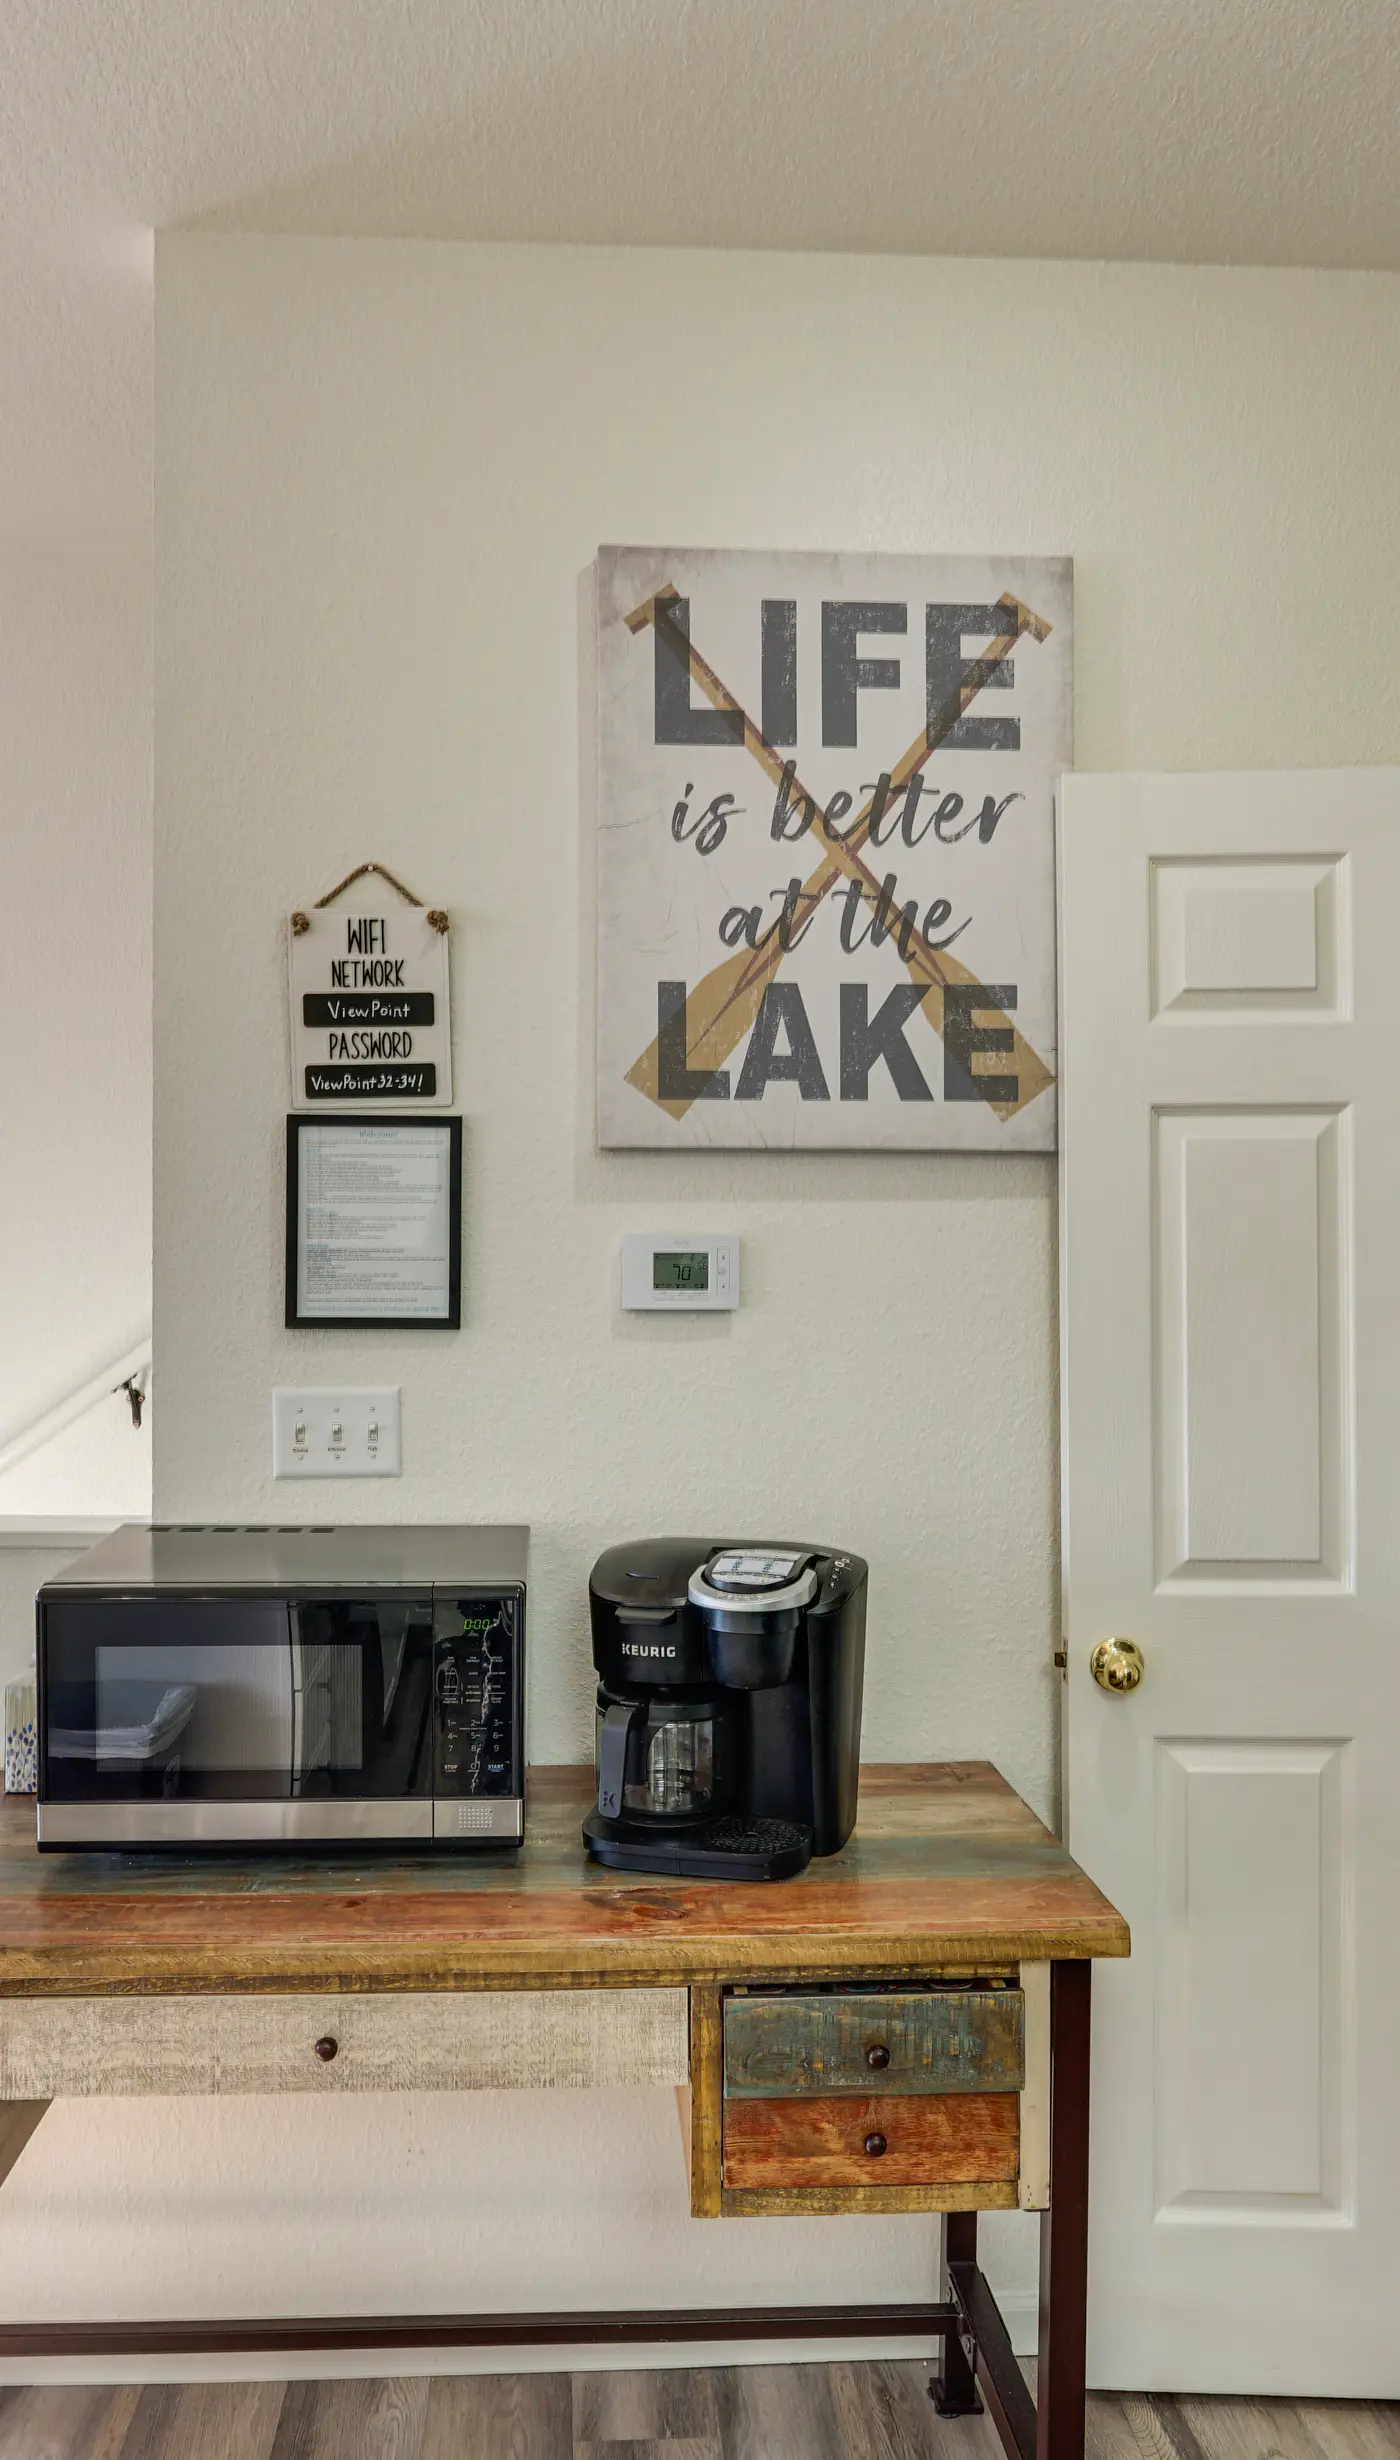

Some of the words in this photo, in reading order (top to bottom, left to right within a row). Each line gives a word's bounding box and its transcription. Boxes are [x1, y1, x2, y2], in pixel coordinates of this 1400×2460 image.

[654, 596, 1021, 751] LIFE
[670, 782, 747, 857] is
[769, 759, 1026, 849] better
[347, 918, 386, 955] WIFI
[718, 877, 818, 954] at
[830, 873, 973, 965] the
[331, 959, 405, 988] NETWORK
[329, 1031, 412, 1060] PASSWORD
[657, 980, 1019, 1102] LAKE
[672, 1265, 691, 1281] 70
[621, 1643, 676, 1658] KEURIG
